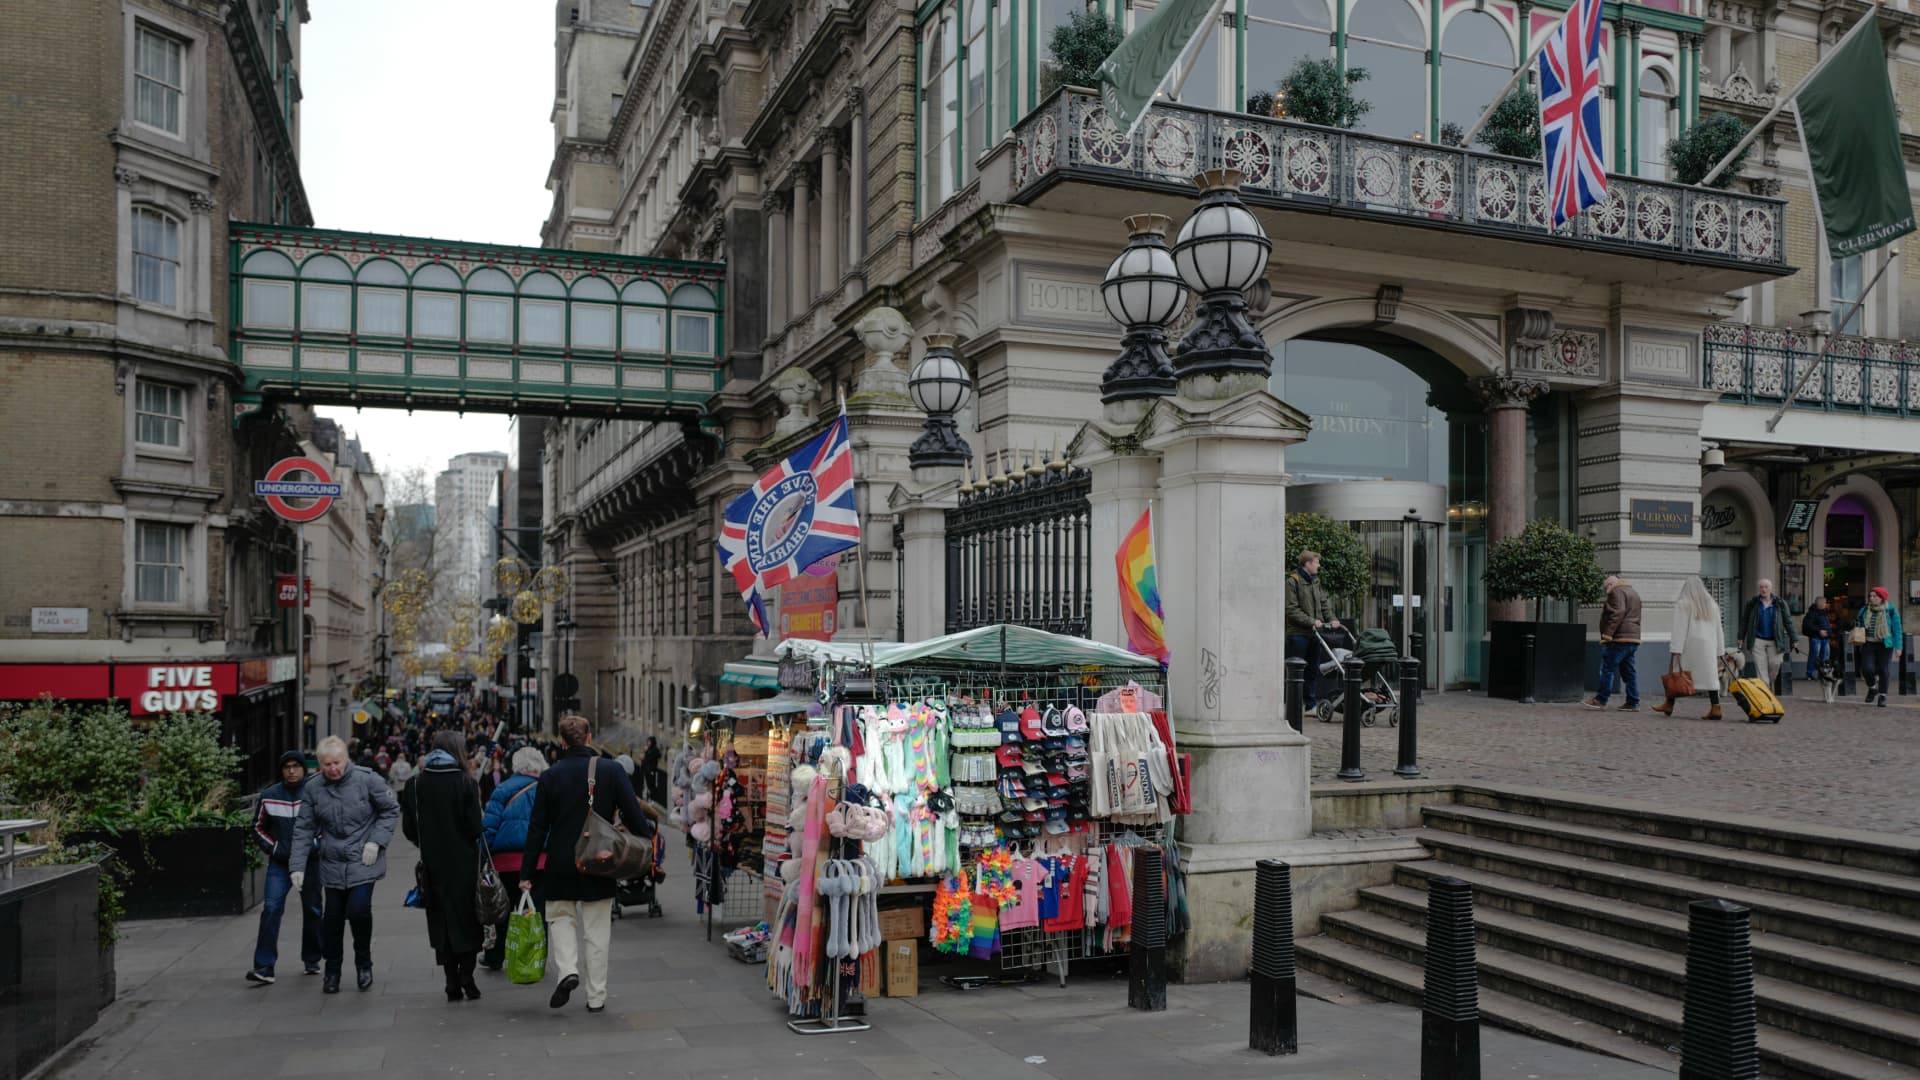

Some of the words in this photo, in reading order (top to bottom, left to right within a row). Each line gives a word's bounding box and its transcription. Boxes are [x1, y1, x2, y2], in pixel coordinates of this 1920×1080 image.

[1838, 216, 1912, 250] CLERMONT
[1029, 283, 1104, 313] HOTEL
[1633, 344, 1687, 370] HOTEL
[259, 483, 339, 495] UNDERGROUND
[1636, 511, 1689, 524] CLERMONT
[1702, 504, 1736, 531] Boots
[38, 617, 60, 625] PLACE
[148, 666, 213, 688] FIVE
[140, 689, 219, 713] GUYS
[1138, 761, 1153, 805] LONDON
